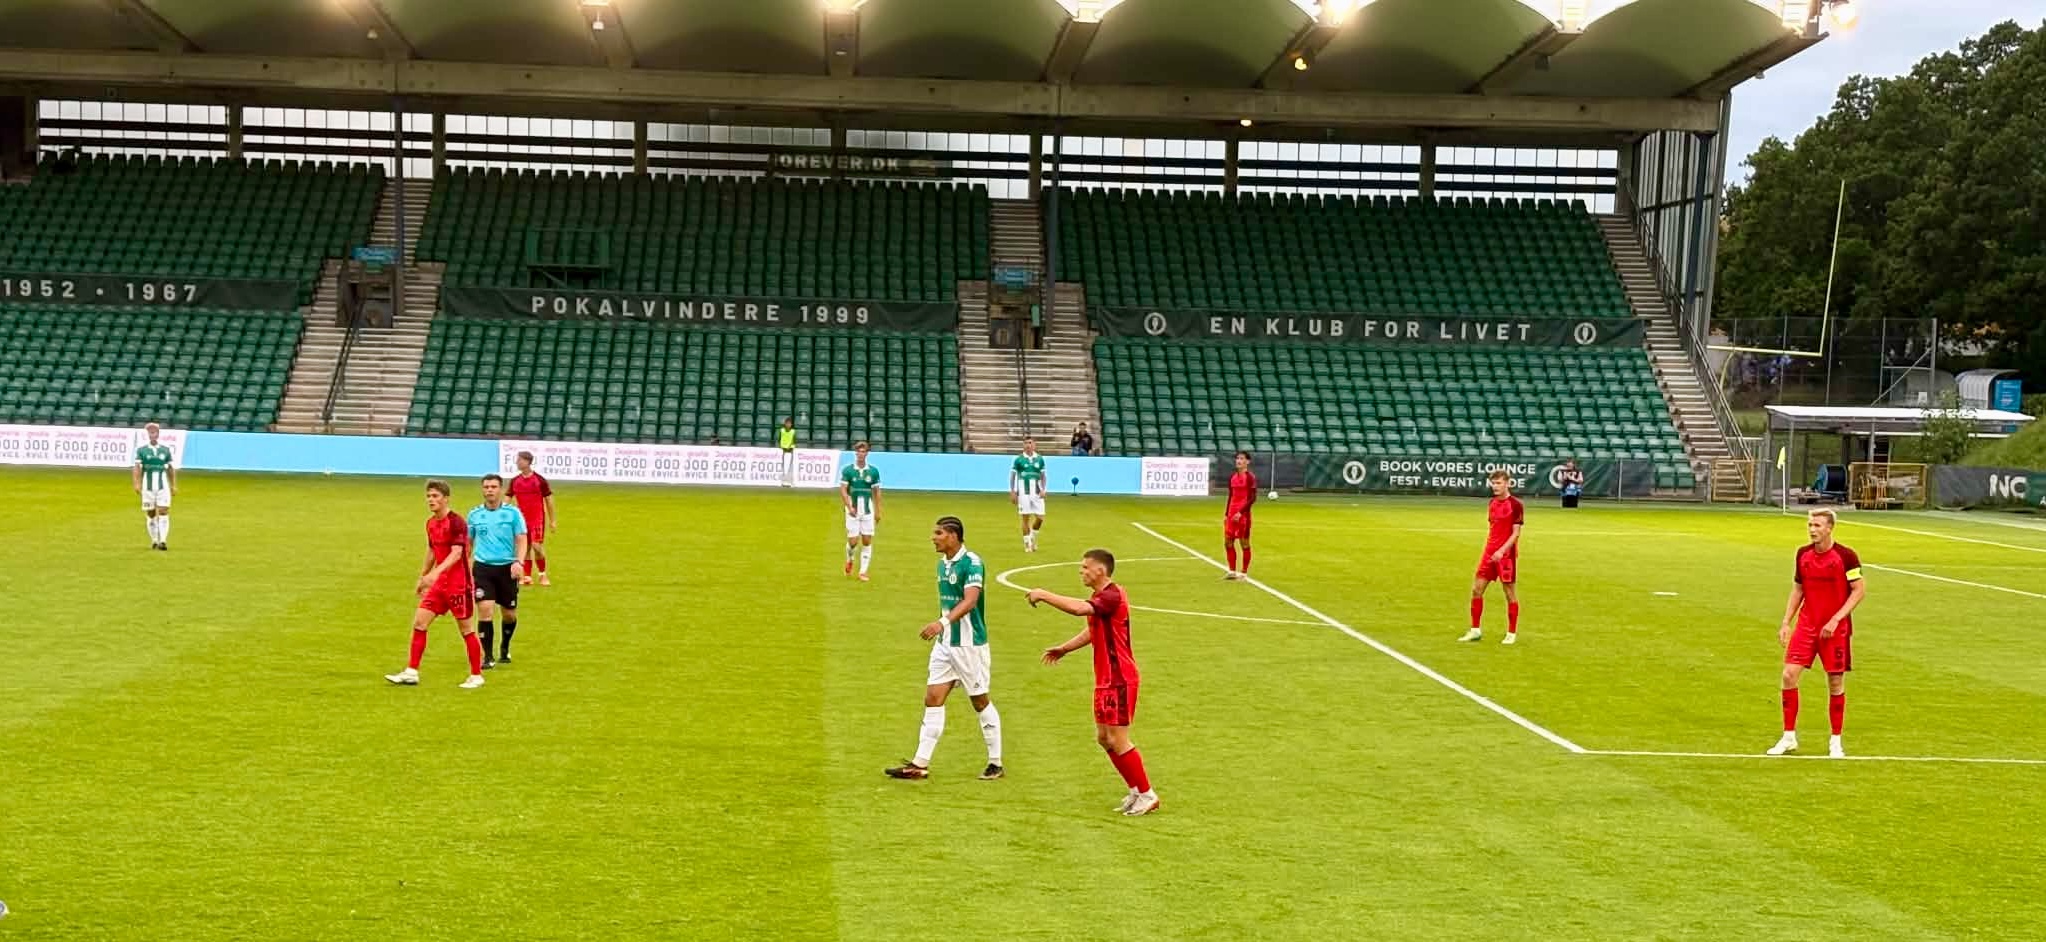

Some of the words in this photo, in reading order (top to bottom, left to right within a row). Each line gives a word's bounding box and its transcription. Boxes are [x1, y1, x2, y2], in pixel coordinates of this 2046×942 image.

[775, 154, 899, 171] OREVER.DK
[3, 279, 75, 298] 1952
[126, 283, 197, 302] 1967
[531, 296, 779, 322] POKALVINDERE
[800, 305, 869, 324] 1999
[1210, 317, 1246, 335] EN
[1266, 318, 1345, 337] KLUB
[1364, 320, 1420, 339] FOR
[1440, 322, 1532, 341] LIVET
[798, 463, 831, 474] FOOD
[1380, 460, 1422, 473] BOOK
[1426, 461, 1473, 474] VORES
[1390, 475, 1421, 486] FEST
[1432, 477, 1474, 488] EVENT
